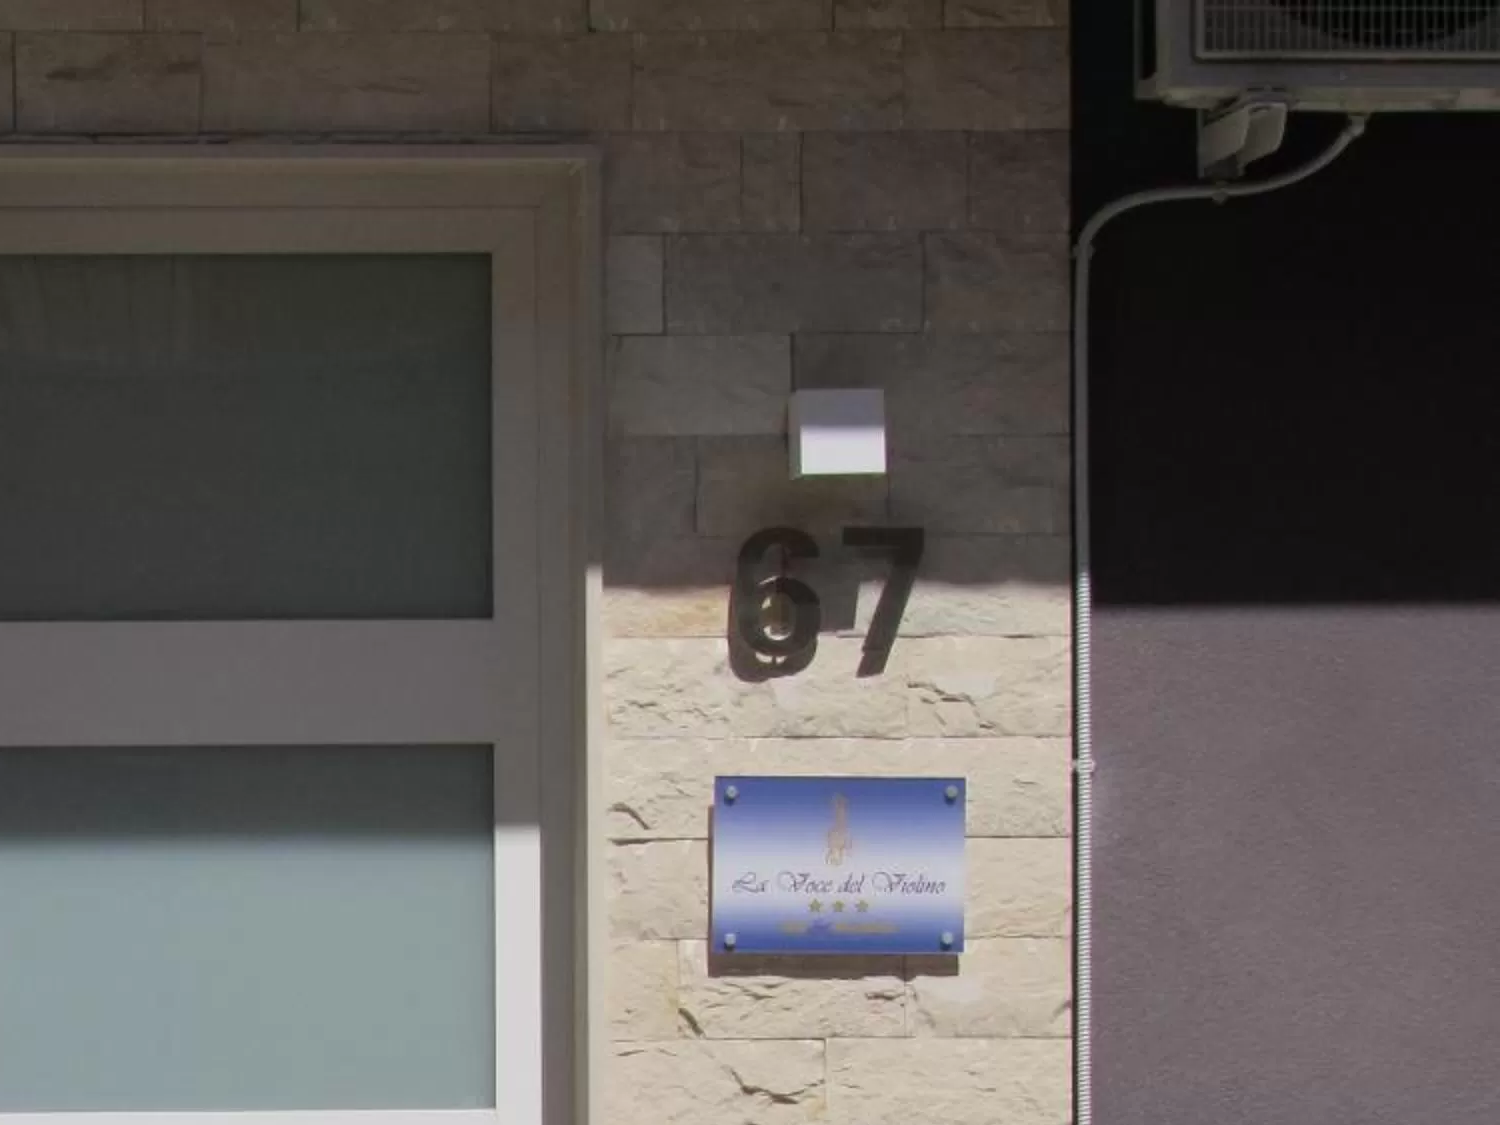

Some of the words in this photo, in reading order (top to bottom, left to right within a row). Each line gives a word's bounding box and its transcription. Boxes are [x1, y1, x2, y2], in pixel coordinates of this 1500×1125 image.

[736, 526, 924, 656] 67
[731, 871, 769, 893] La
[777, 871, 833, 893] Voce
[837, 872, 865, 893] del
[871, 871, 946, 894] Violino
